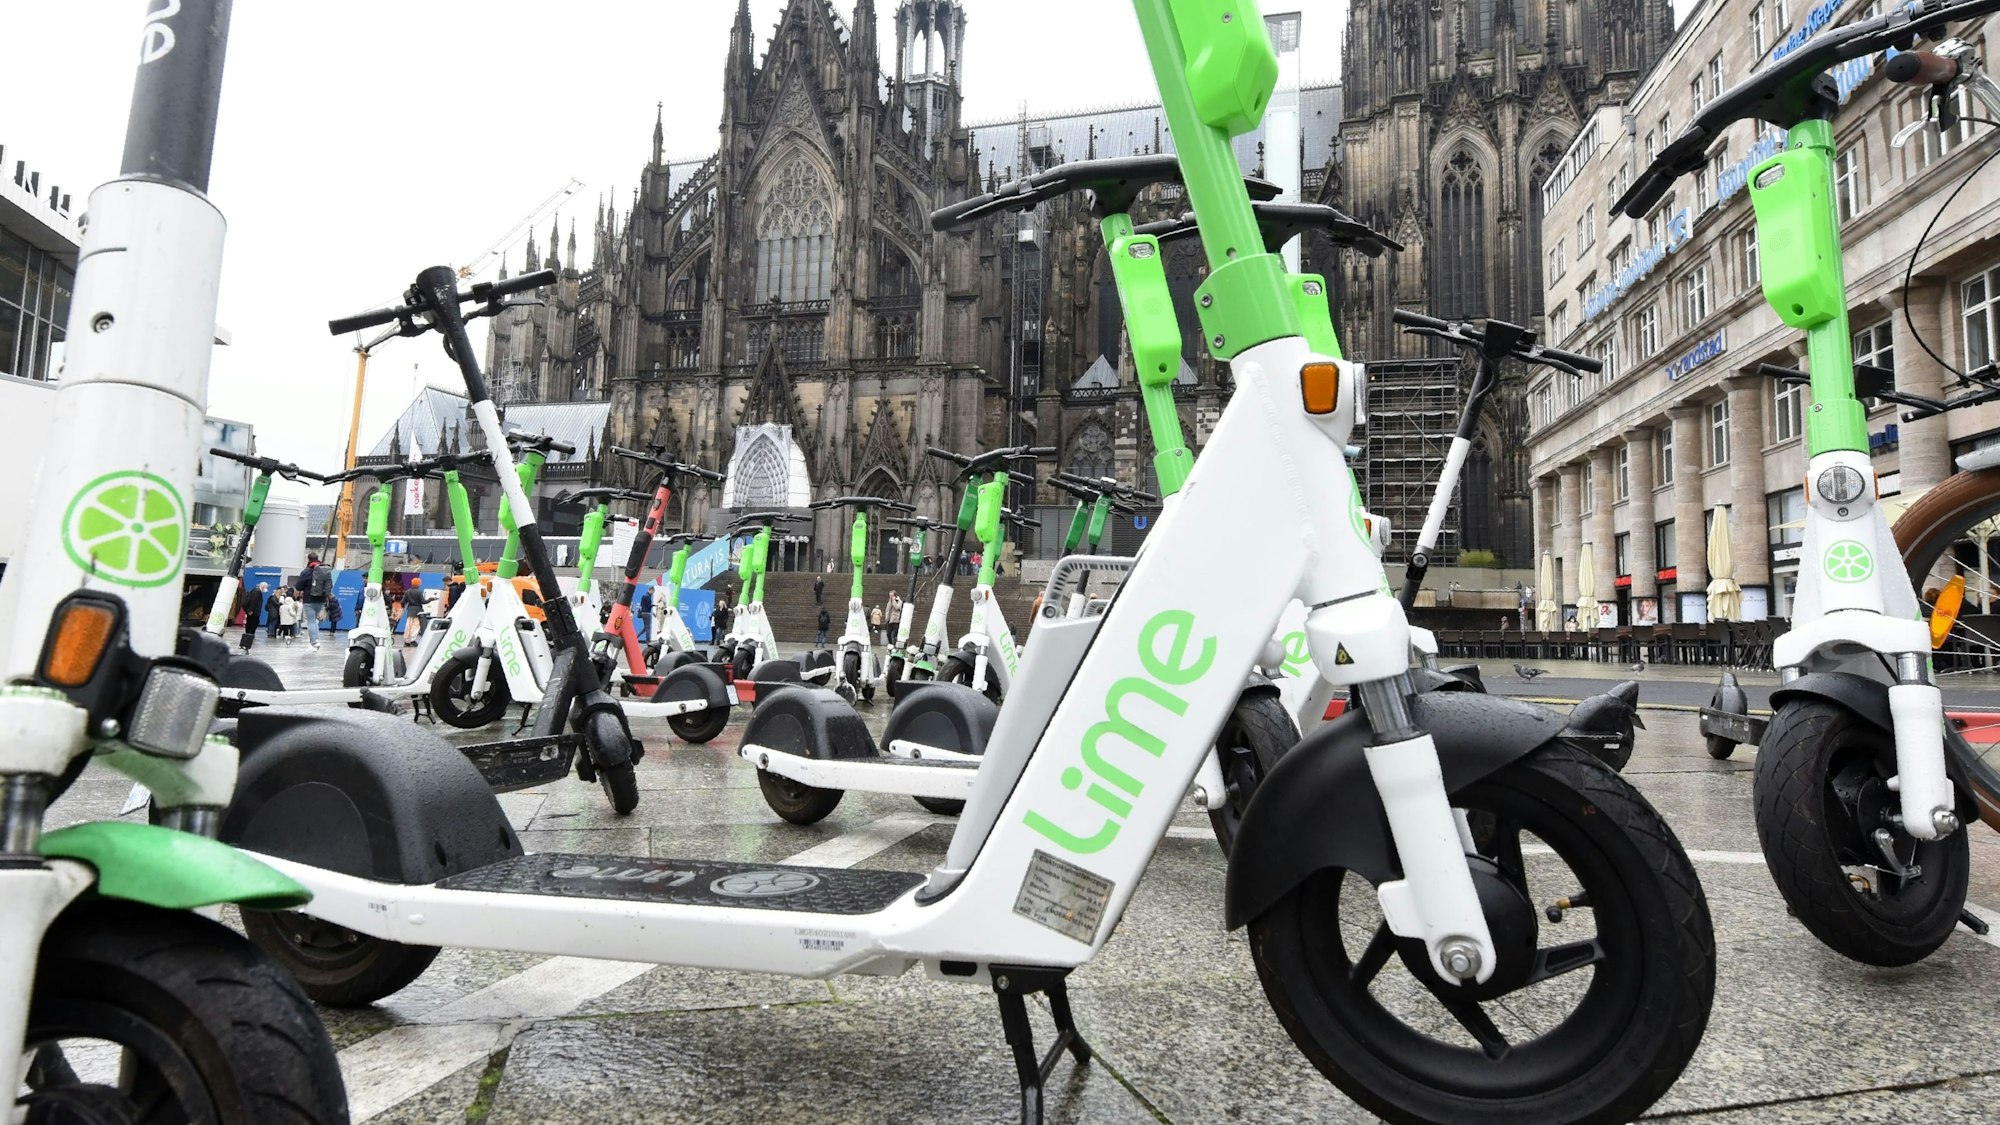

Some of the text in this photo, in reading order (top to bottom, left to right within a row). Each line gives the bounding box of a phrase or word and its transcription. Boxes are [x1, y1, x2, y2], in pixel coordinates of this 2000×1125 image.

[1677, 330, 1722, 375] randstad
[1134, 516, 1147, 529] U
[499, 625, 521, 677] Lime
[1022, 609, 1217, 854] Lime
